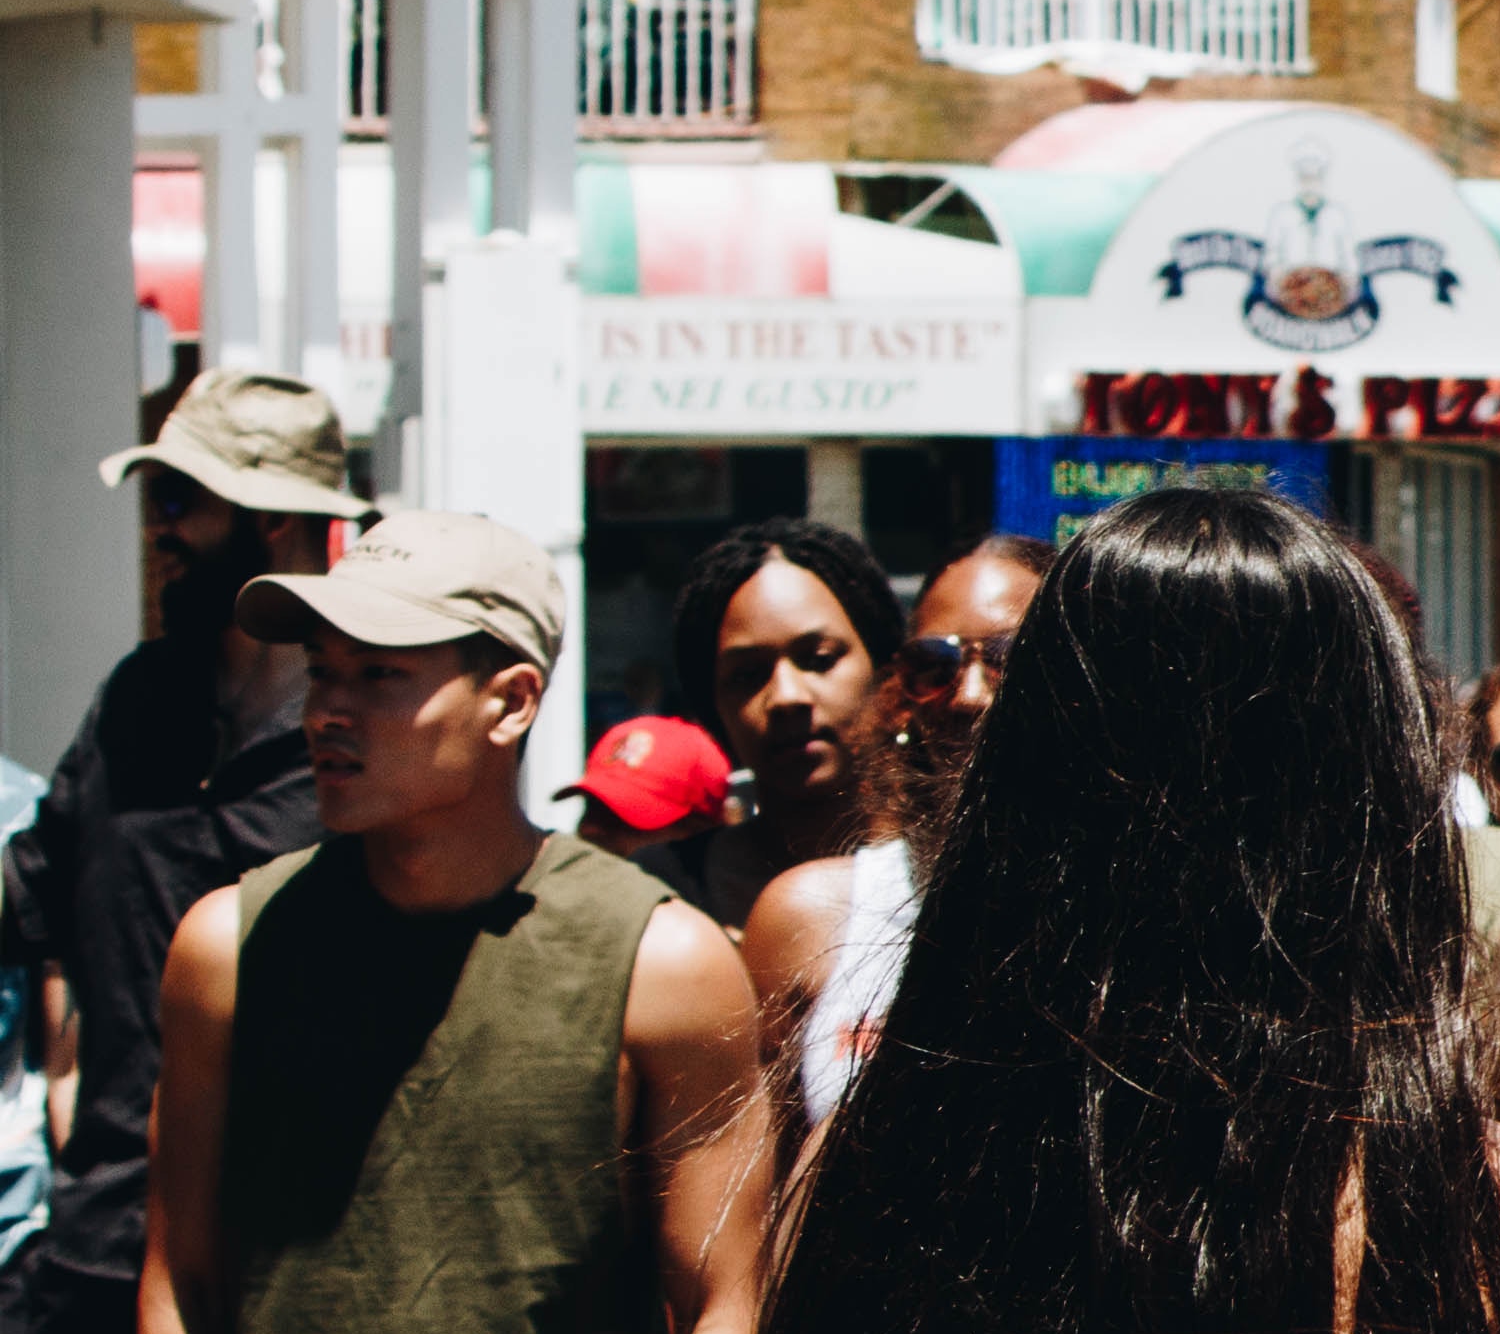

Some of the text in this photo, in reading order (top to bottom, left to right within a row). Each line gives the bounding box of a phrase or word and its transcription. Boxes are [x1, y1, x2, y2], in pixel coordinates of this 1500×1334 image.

[600, 320, 641, 360] IS
[656, 320, 705, 360] IN
[724, 320, 812, 360] THE
